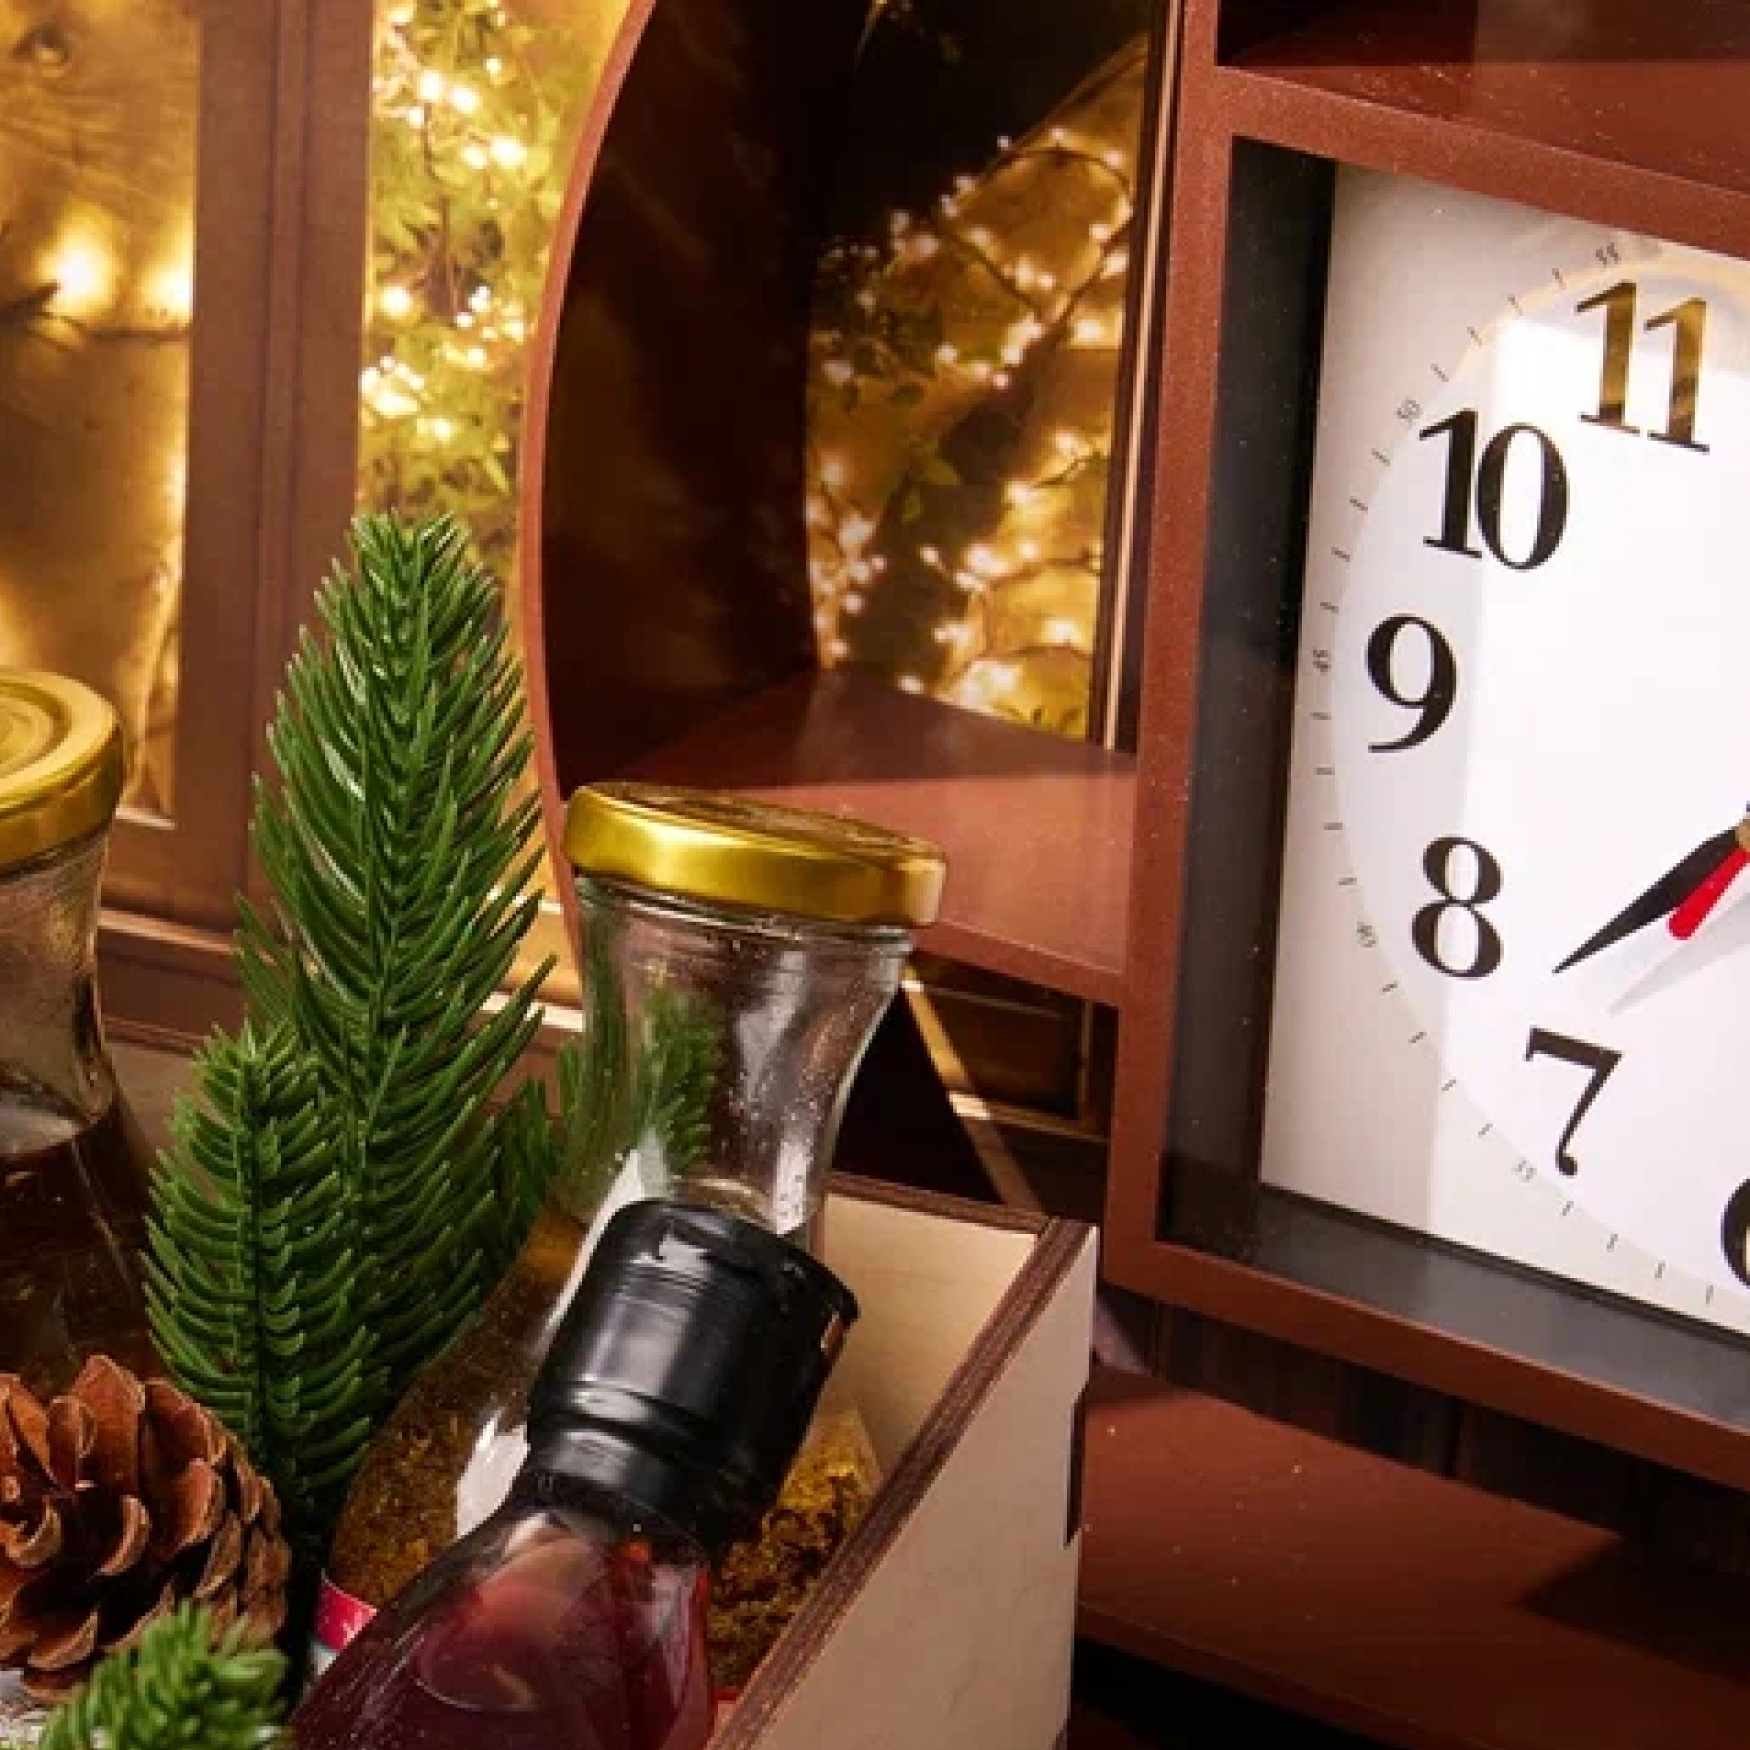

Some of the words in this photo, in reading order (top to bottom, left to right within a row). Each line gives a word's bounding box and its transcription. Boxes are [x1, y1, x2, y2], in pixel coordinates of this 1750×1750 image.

[1575, 279, 1710, 453] 11
[1418, 407, 1570, 572] 10
[1365, 612, 1458, 754] 9
[1411, 834, 1504, 981] 8
[1525, 1026, 1623, 1177] 7
